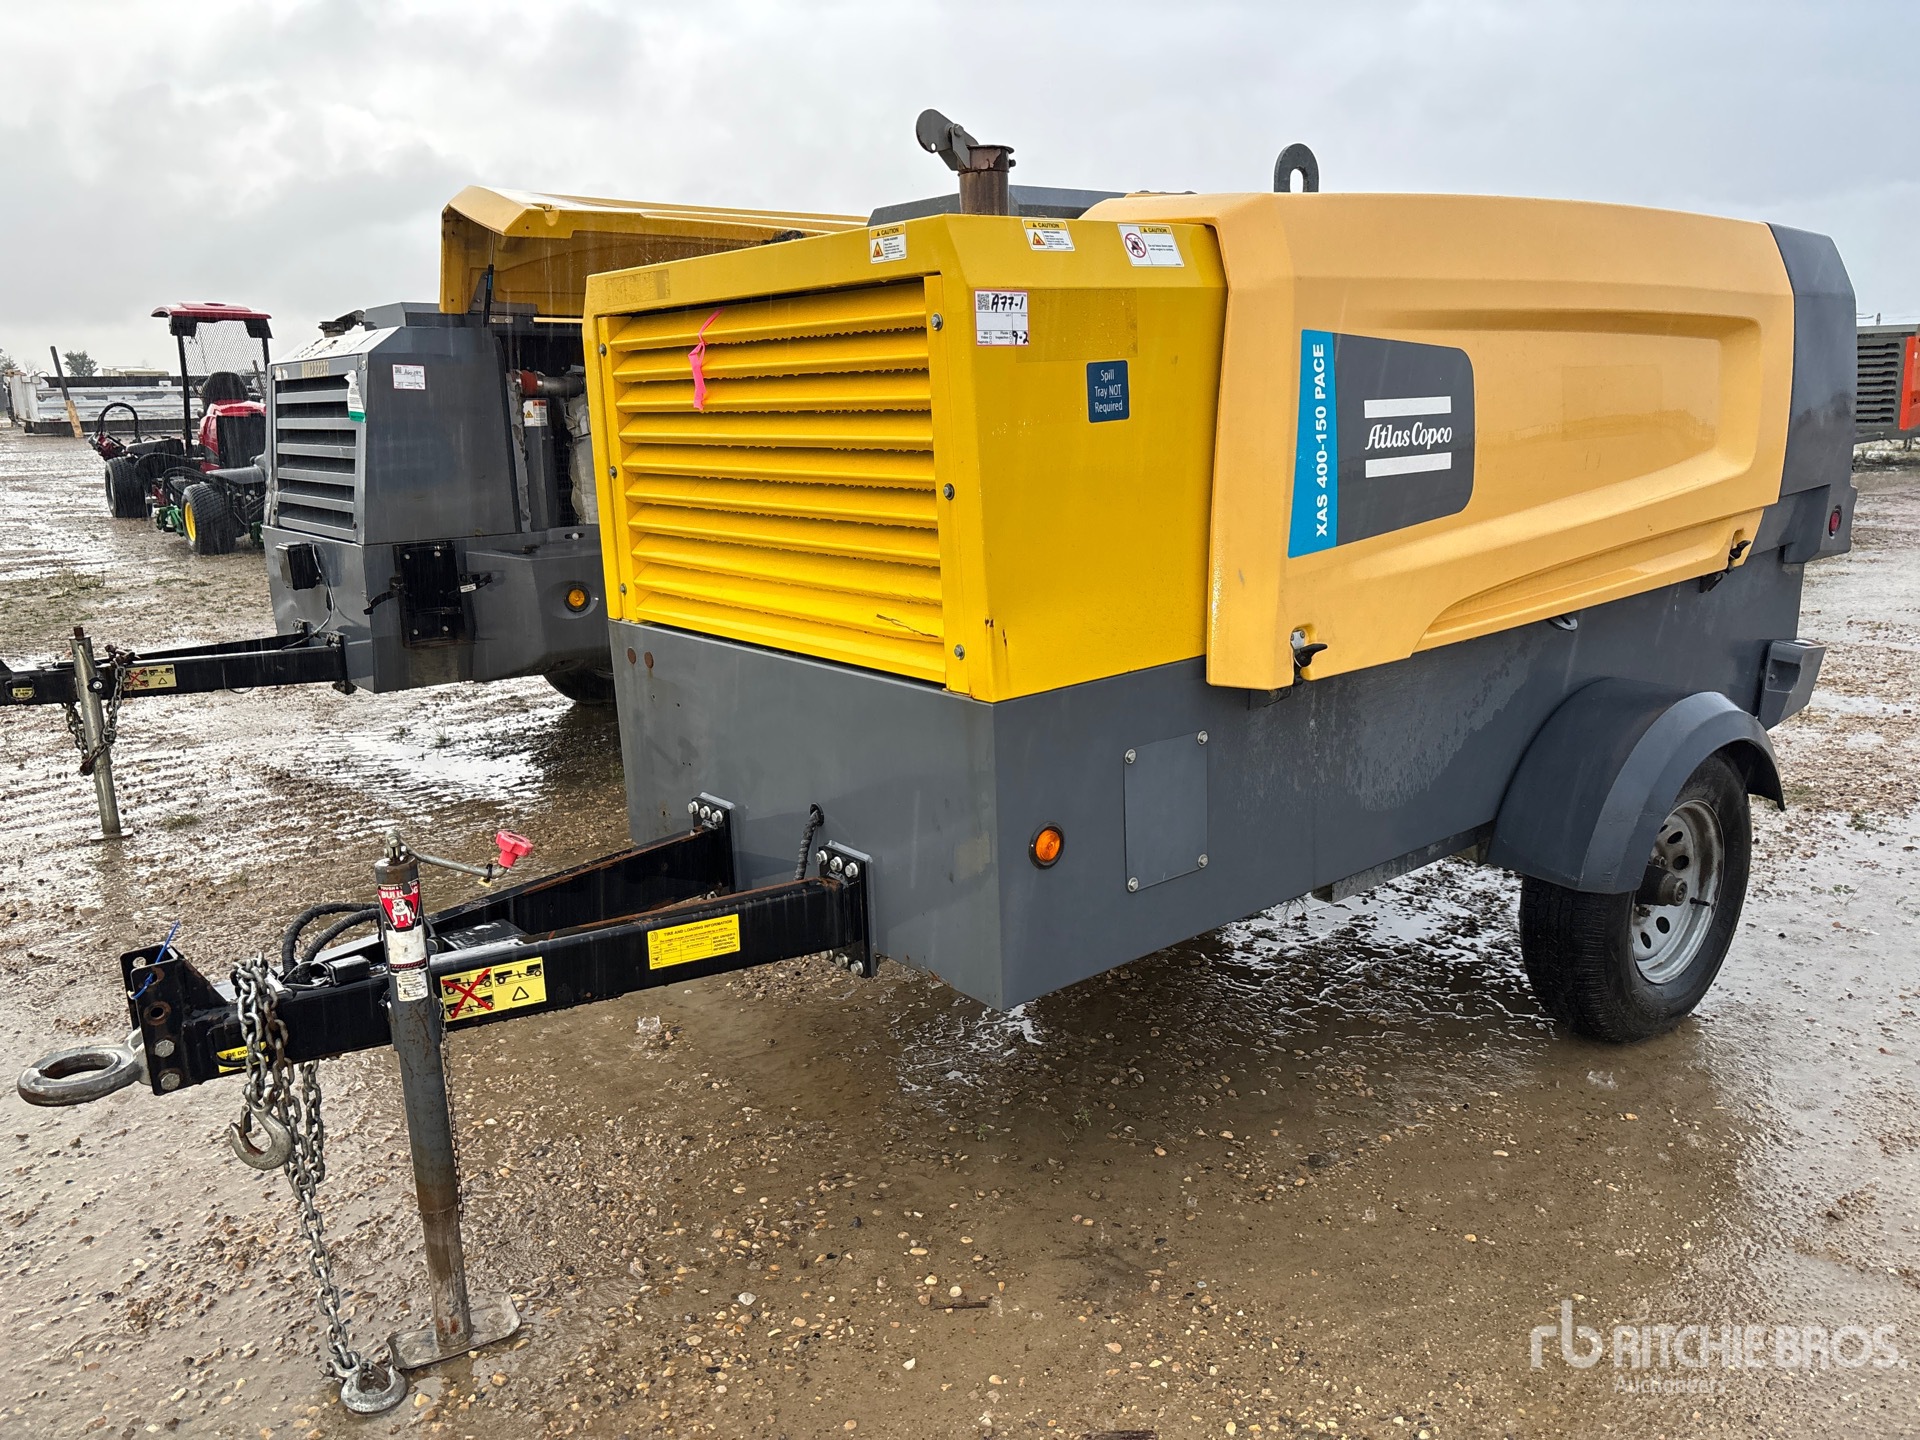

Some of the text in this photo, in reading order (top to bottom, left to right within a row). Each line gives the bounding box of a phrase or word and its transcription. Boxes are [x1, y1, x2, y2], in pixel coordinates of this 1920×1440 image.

[881, 227, 899, 236] CAUTION
[1100, 369, 1115, 383] Spill
[1094, 384, 1122, 399] Tray NOT
[1094, 399, 1123, 414] Required
[1312, 343, 1328, 537] XAS 400-150 PACE
[683, 925, 704, 933] LOADING
[704, 919, 733, 929] INFORMATION
